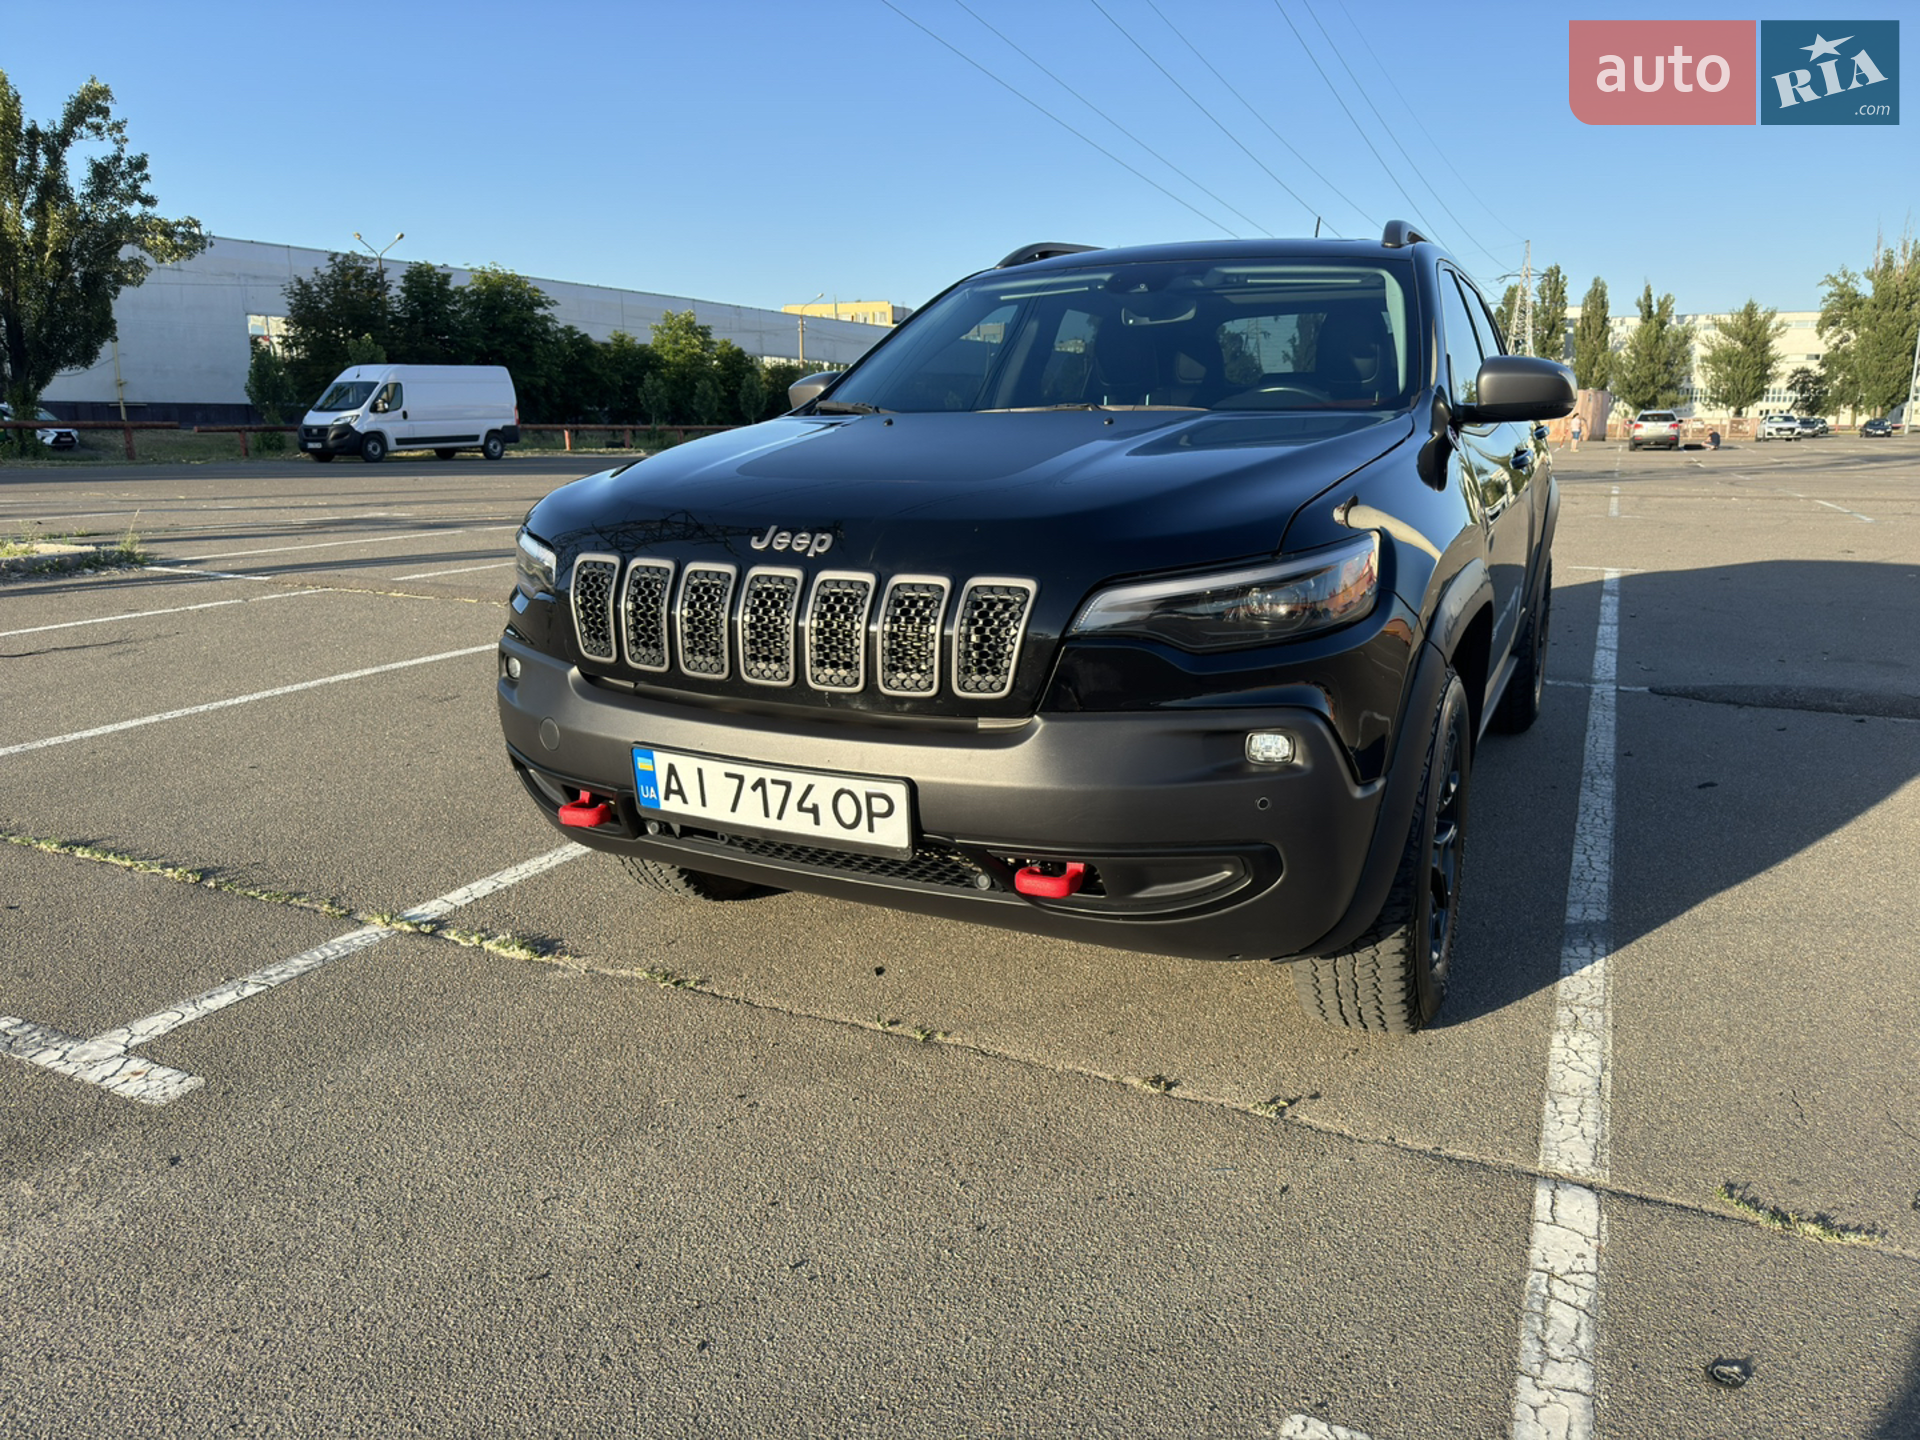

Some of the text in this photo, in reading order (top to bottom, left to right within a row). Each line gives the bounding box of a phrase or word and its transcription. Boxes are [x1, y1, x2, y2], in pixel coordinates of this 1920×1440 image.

[750, 525, 833, 557] Jeep
[640, 785, 657, 800] UA
[663, 762, 896, 833] AI 7174 OP
